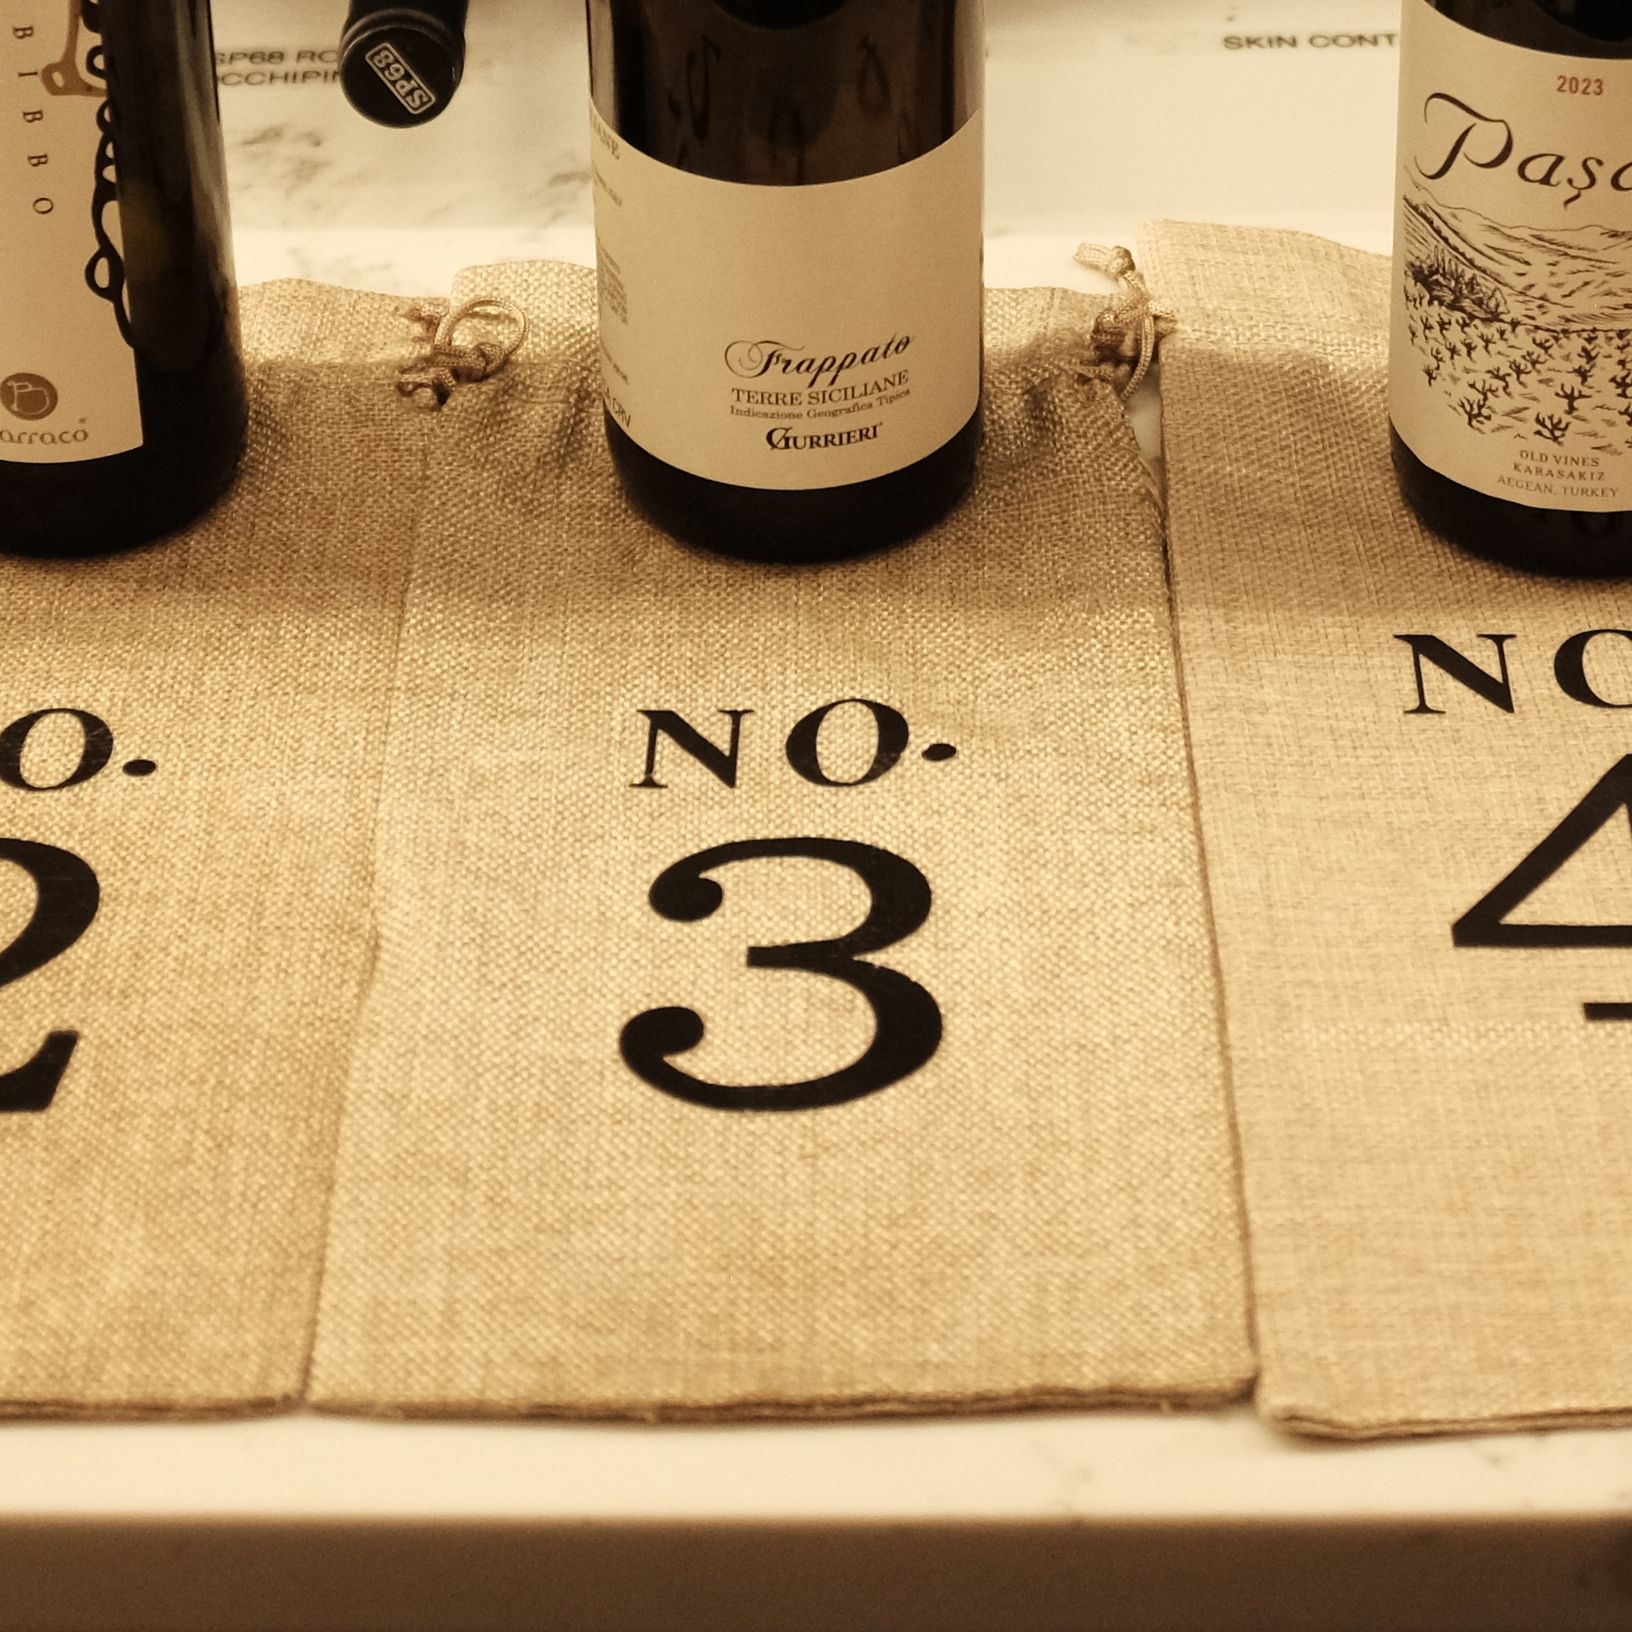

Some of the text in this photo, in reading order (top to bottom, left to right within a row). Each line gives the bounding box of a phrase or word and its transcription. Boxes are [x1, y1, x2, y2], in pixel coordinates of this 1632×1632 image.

[1223, 33, 1396, 50] SKIN CONT
[217, 70, 340, 86] CCHIPI
[371, 48, 429, 109] SP68
[1556, 74, 1604, 97] 2023
[724, 332, 914, 389] Frappato
[730, 368, 910, 407] TERRE SICILIANE
[729, 387, 912, 421] Indicazione Geografica Tipica
[765, 424, 880, 451] GURRIERI
[1512, 462, 1607, 482] KARASAKIZ
[1518, 448, 1600, 470] OLD VINES
[1560, 483, 1620, 500] TURKEY
[629, 698, 957, 789] NO.
[619, 836, 943, 1112] 3
